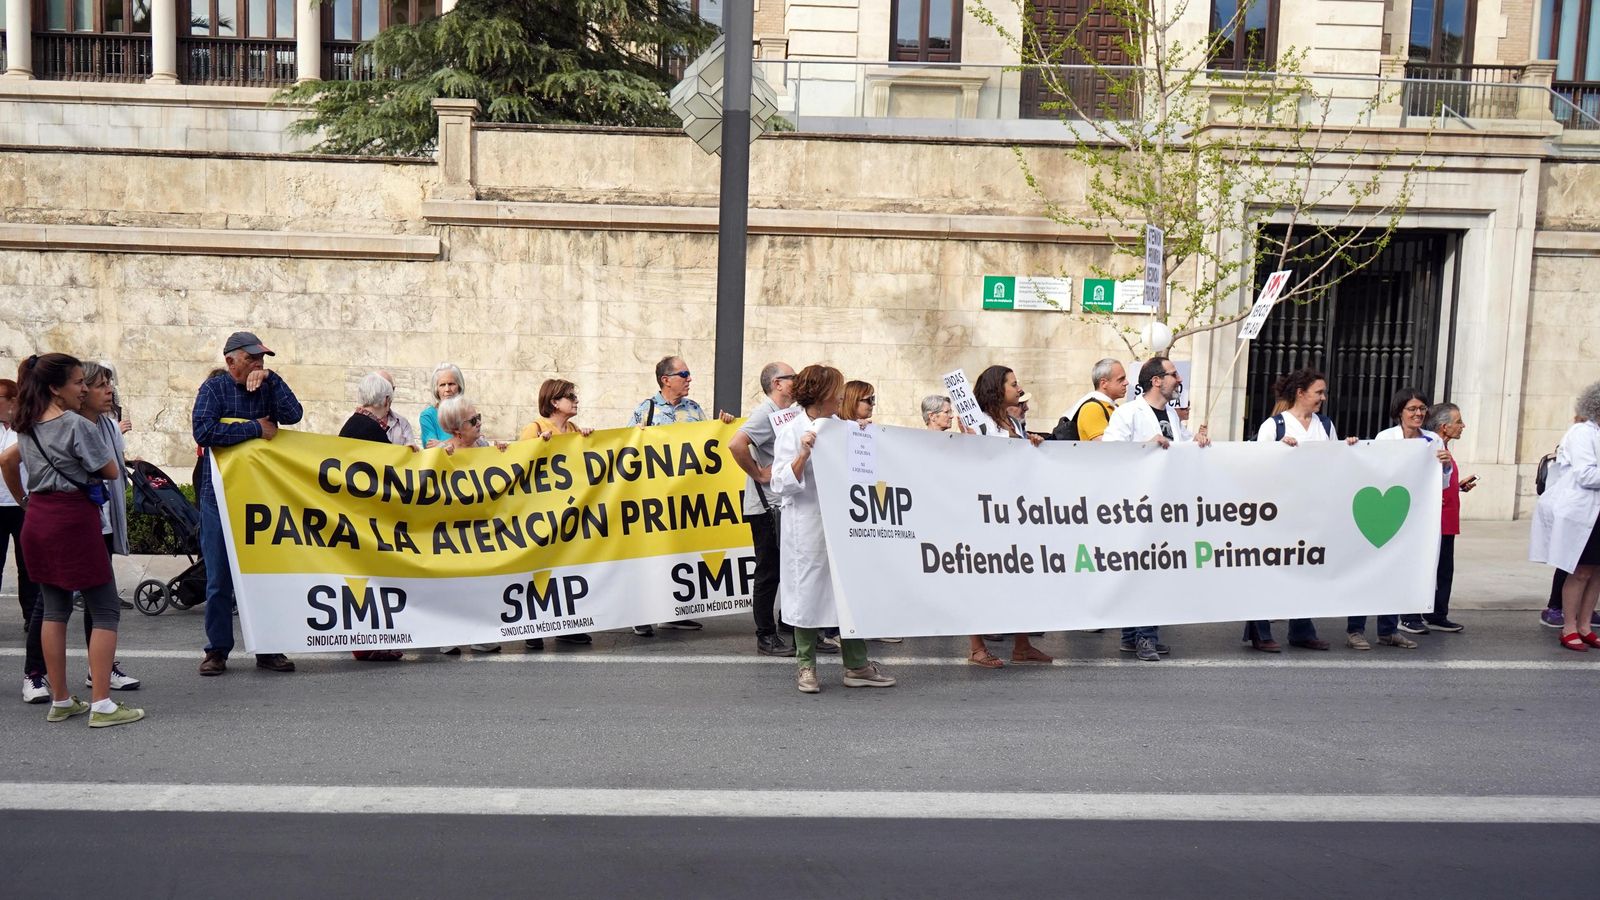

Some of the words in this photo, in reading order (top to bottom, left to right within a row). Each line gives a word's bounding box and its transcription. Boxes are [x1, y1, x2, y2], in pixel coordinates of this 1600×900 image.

[773, 415, 784, 426] LA
[318, 454, 573, 506] CONDICIONES
[583, 439, 722, 486] DIGNAS
[849, 484, 912, 526] SMP
[978, 494, 1009, 525] Tu
[1017, 495, 1089, 525] Salud
[1096, 495, 1154, 525] está
[1160, 501, 1189, 523] en
[1195, 496, 1278, 527] juego
[245, 503, 360, 550] PARA
[369, 518, 421, 555] LA
[432, 496, 609, 555] ATENCIÓN
[849, 528, 876, 538] SINDICATO
[878, 527, 894, 538] MÉDICO
[894, 529, 916, 539] PRIMARIA
[920, 542, 1035, 574] Defiende
[1040, 544, 1066, 574] la
[1074, 542, 1188, 573] Atención
[1195, 540, 1326, 569] Primaria
[671, 556, 756, 602] SMP
[307, 585, 407, 631] SMP
[500, 575, 589, 624] SMP
[674, 603, 705, 616] SINDICATO
[706, 599, 733, 613] MÉDICO
[307, 634, 348, 647] SINDICATO
[350, 632, 378, 646] MÉDICO
[379, 633, 413, 644] PRIMARIA
[501, 623, 535, 637] SINDICATO
[536, 620, 562, 633] MÉDICO
[563, 617, 594, 629] PRIMARIA
